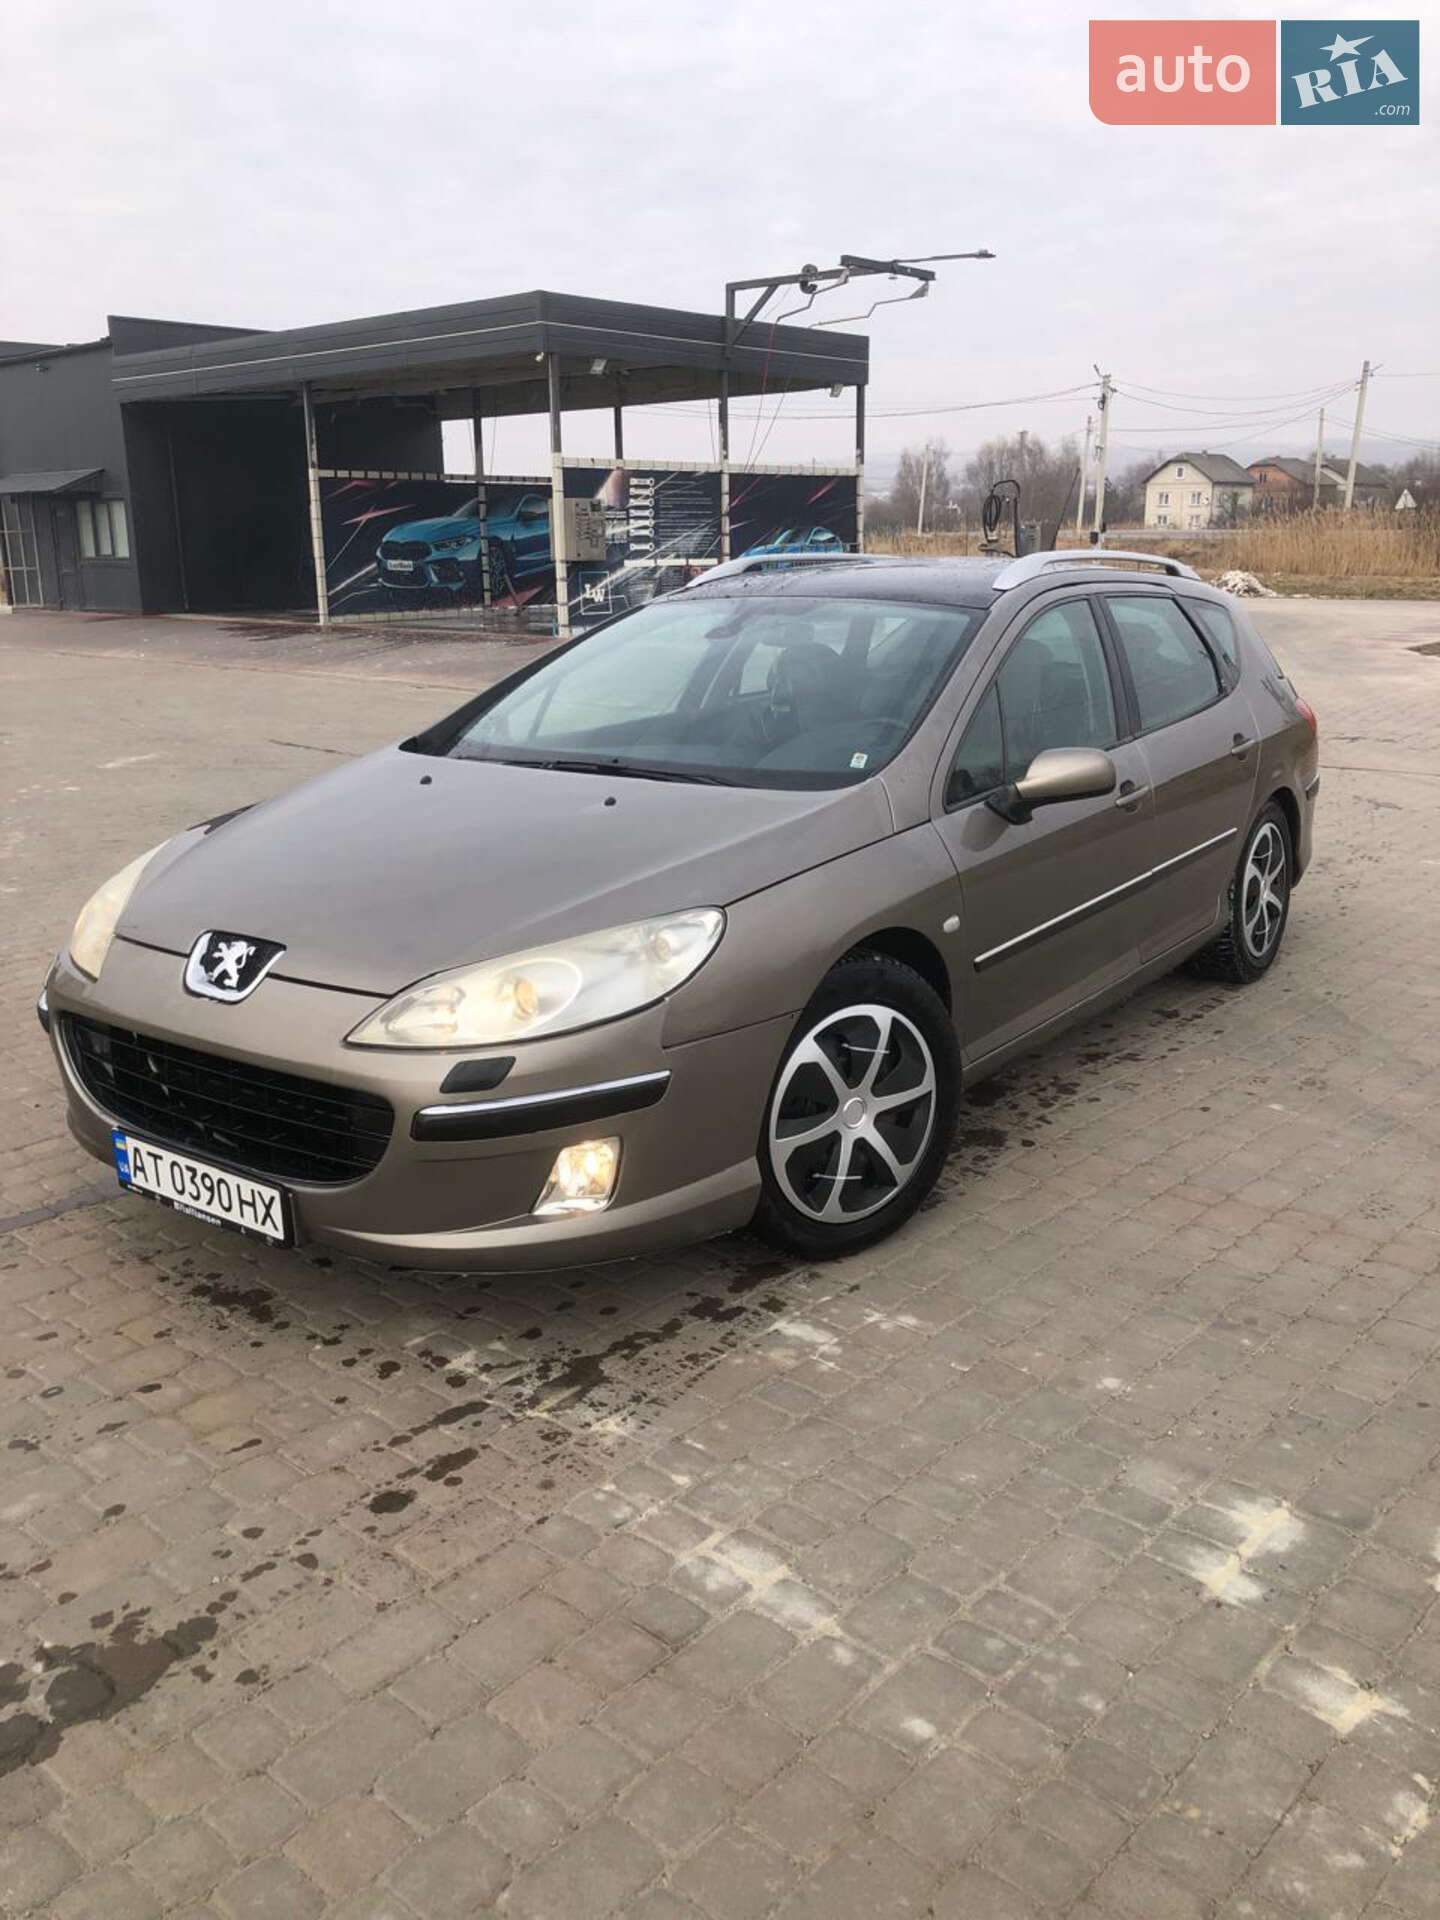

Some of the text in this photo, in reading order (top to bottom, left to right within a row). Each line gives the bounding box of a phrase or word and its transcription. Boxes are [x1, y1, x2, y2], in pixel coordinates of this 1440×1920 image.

[132, 1147, 279, 1232] AT 0390 HX
